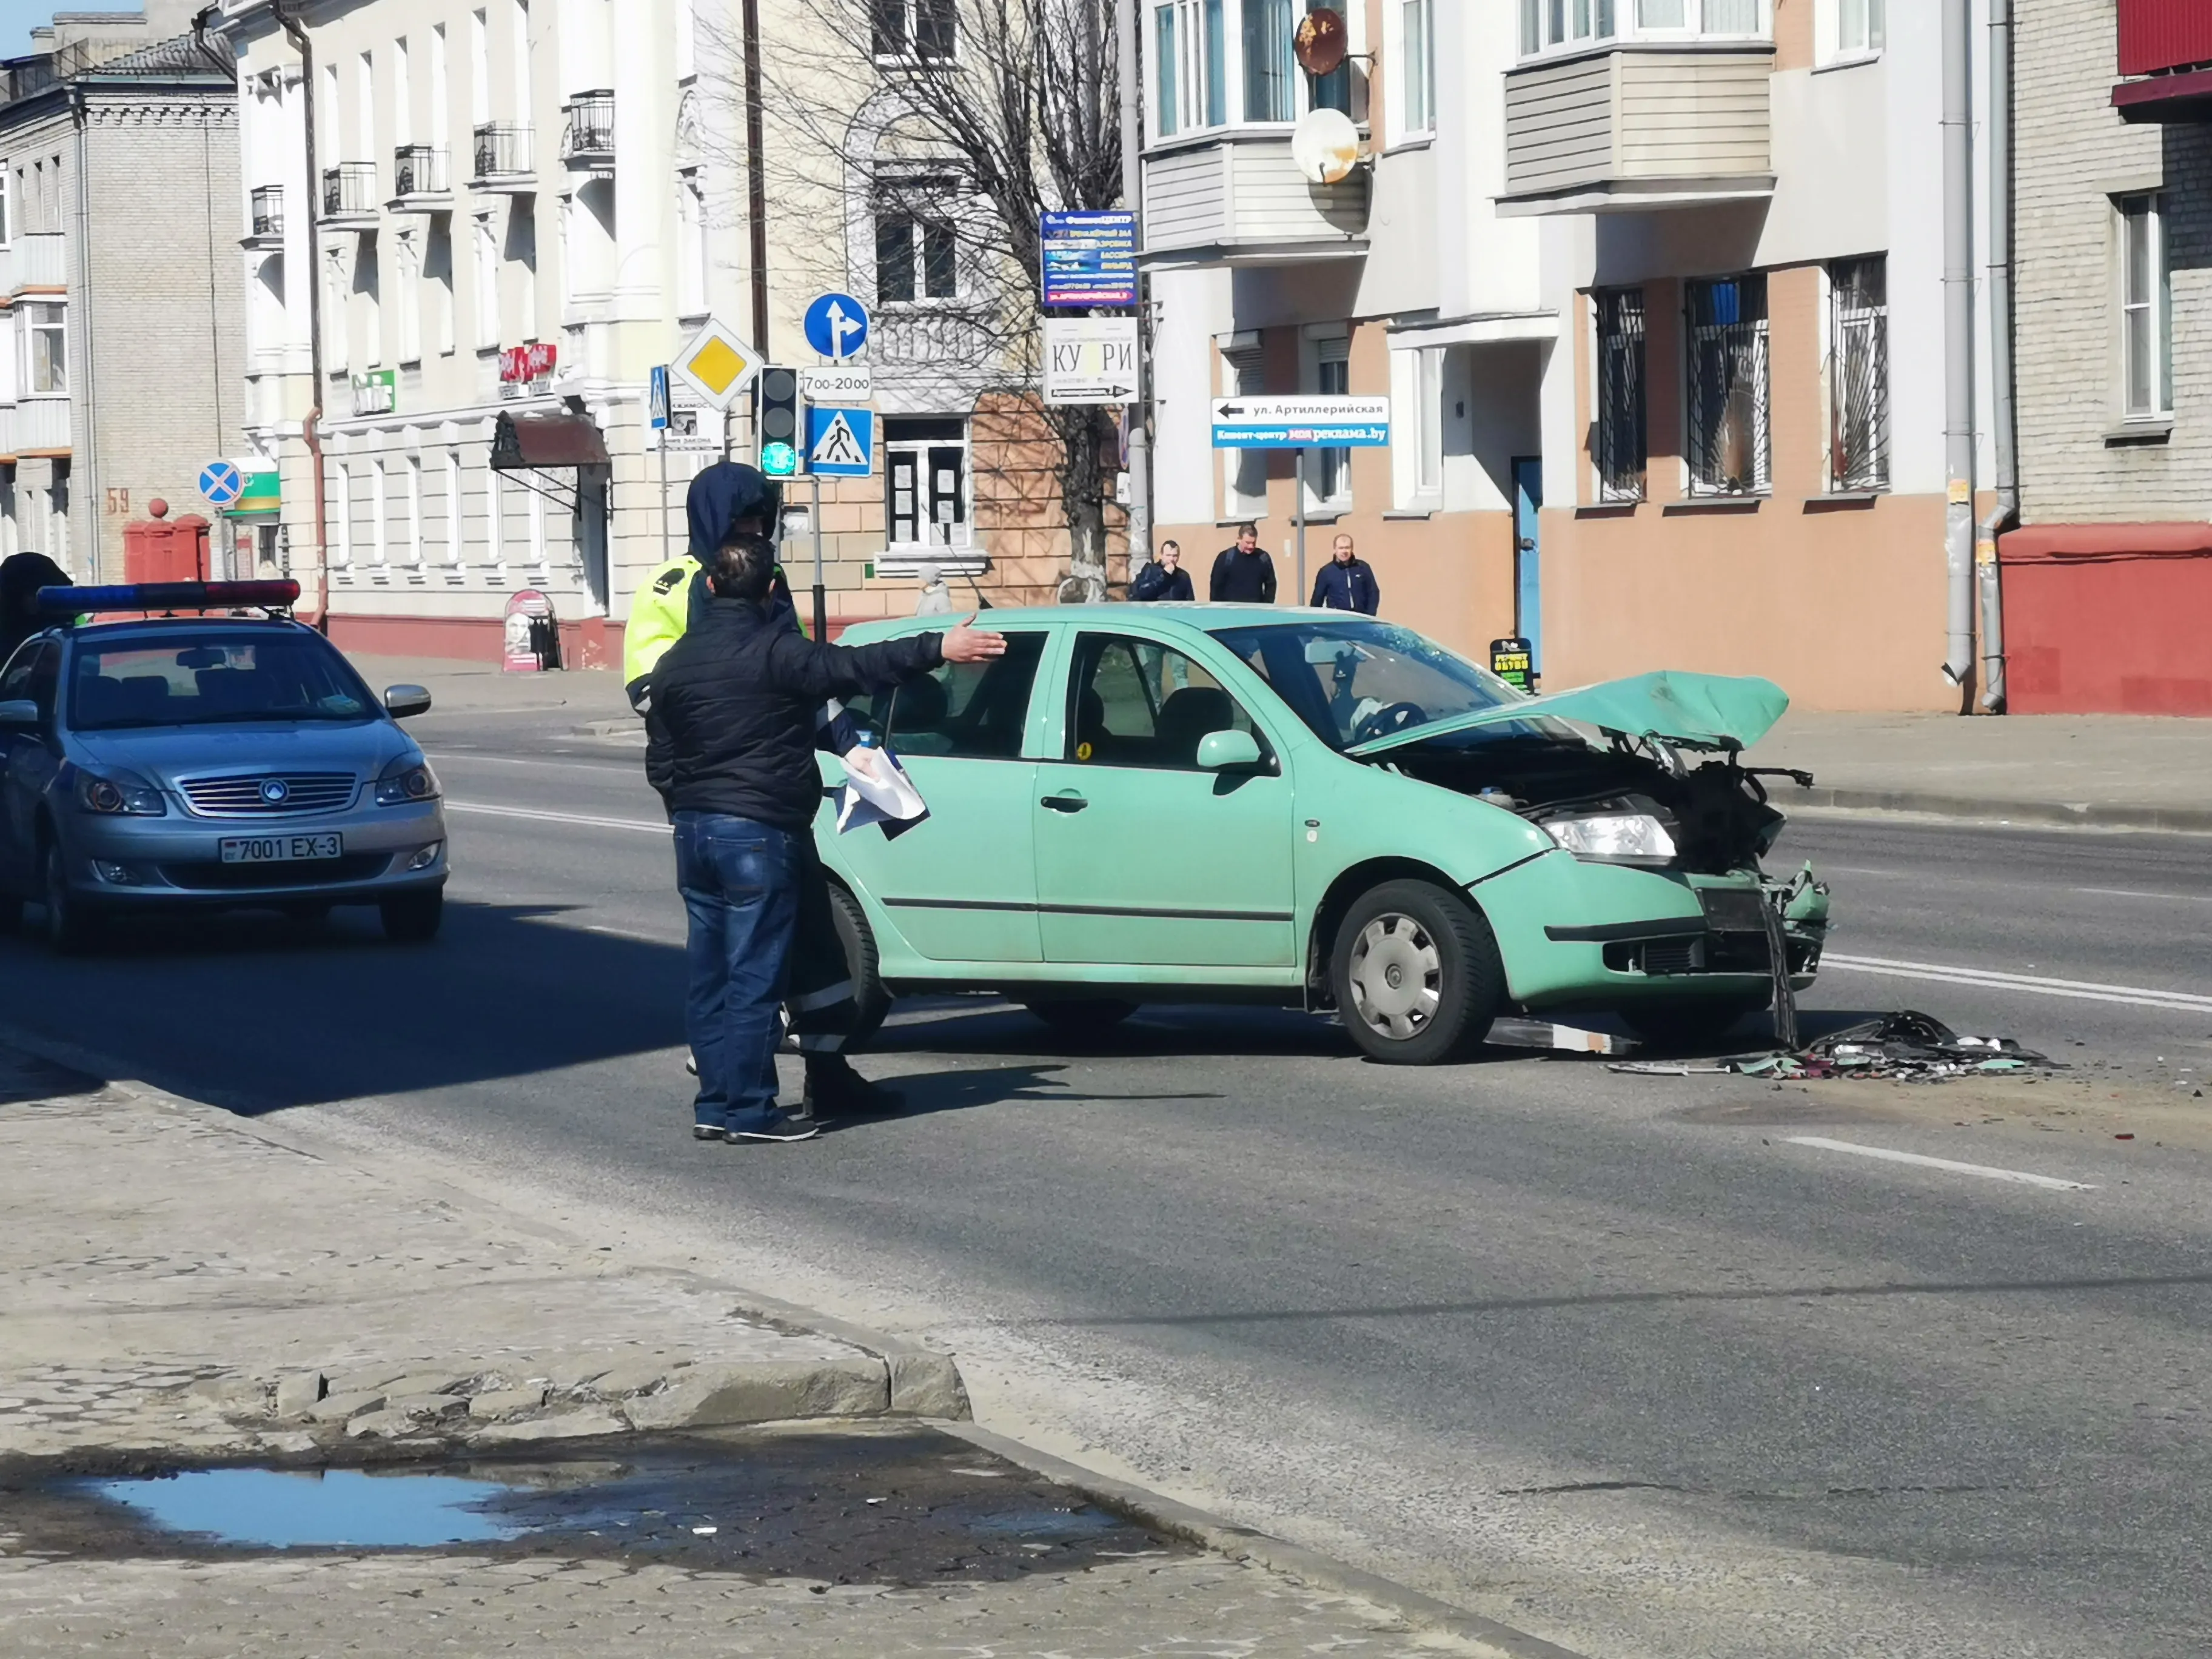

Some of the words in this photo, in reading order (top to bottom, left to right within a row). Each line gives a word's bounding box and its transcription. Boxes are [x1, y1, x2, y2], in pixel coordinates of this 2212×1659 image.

[1253, 407, 1272, 417] ул.
[1275, 404, 1384, 415] Артиллерийская
[106, 488, 130, 514] 59
[240, 839, 283, 860] 7001
[291, 837, 338, 857] EX-3
